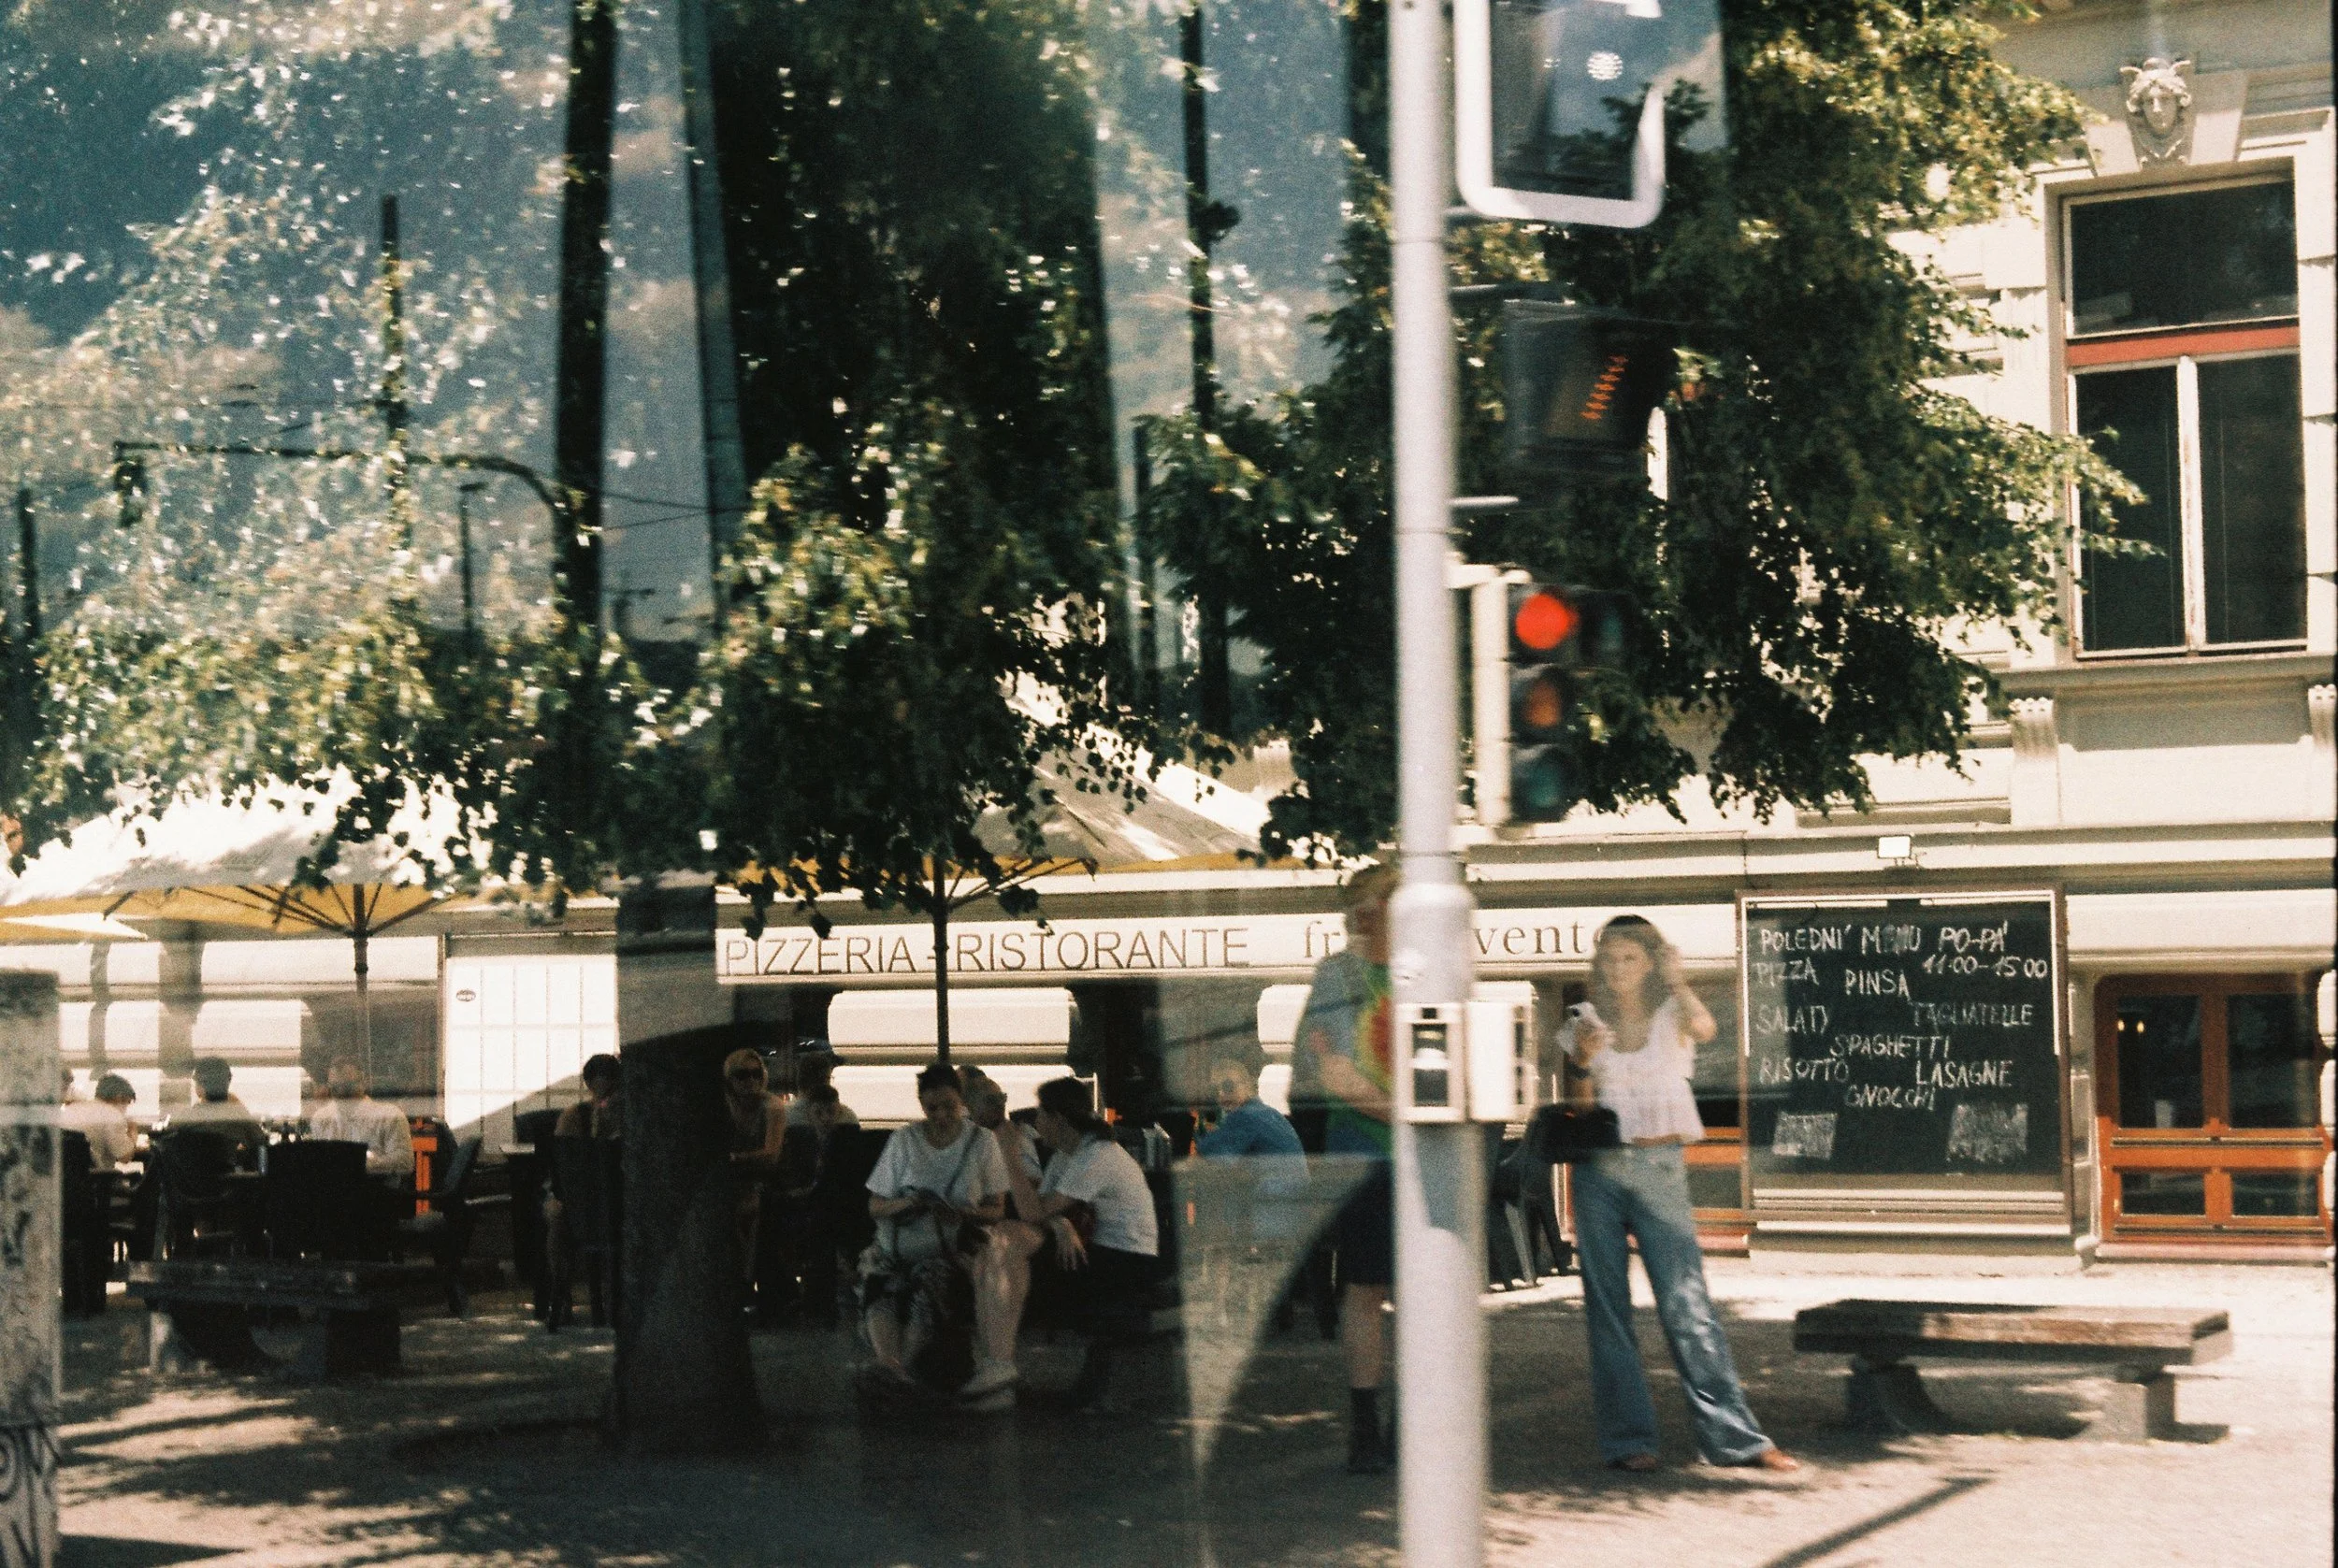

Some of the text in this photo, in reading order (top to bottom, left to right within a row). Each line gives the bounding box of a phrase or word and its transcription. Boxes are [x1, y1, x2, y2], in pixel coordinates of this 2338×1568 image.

[726, 936, 916, 975] PIZZERIA
[957, 928, 1248, 972] RISTORANTE
[1473, 919, 1599, 956] vent
[1861, 924, 1922, 957] MU
[1754, 957, 1820, 988] PIZZA
[1844, 968, 1913, 1001] PINSA
[1828, 1032, 1951, 1059] SPAGHETTI
[1758, 1057, 2013, 1088] RISOTTO LASAGNE
